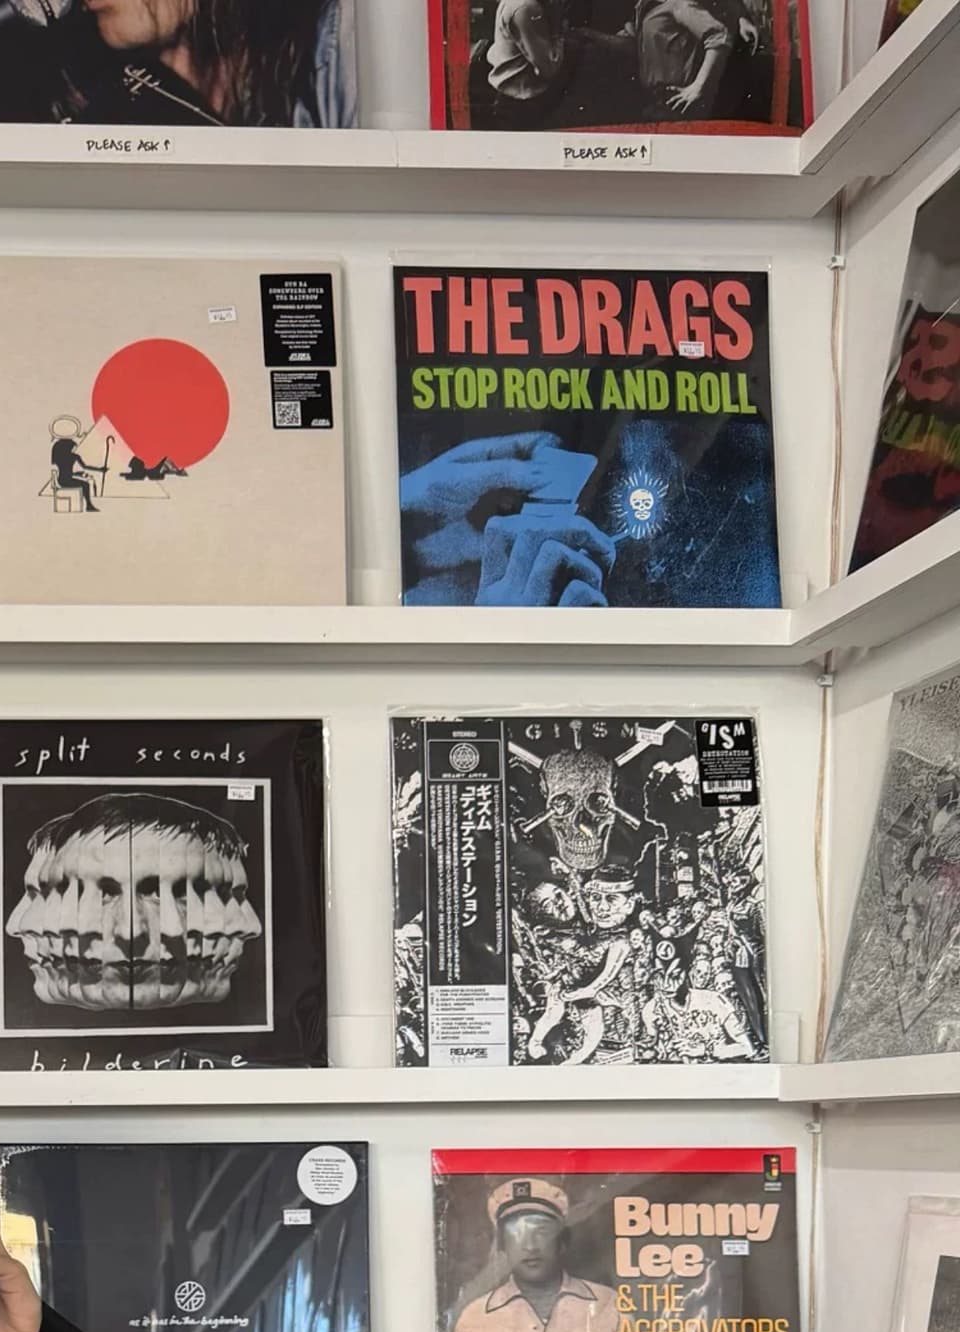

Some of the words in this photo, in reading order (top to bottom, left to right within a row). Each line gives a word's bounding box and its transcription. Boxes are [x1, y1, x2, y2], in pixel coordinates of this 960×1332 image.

[86, 138, 132, 152] PLEASE
[137, 138, 159, 152] ASK
[563, 146, 608, 160] PLEASE
[614, 146, 638, 159] ASK
[403, 275, 529, 356] THE
[535, 277, 754, 361] DRAGS
[412, 366, 497, 411] STOP
[503, 367, 593, 411] ROCK
[600, 368, 670, 414] AND
[676, 370, 758, 415] ROLL
[14, 735, 91, 775] split
[135, 742, 248, 765] seconds
[613, 1197, 780, 1242] Bunny
[615, 1237, 705, 1279] Lee
[617, 1283, 637, 1313] &
[638, 1283, 685, 1313] THE
[200, 1315, 250, 1329] beginning
